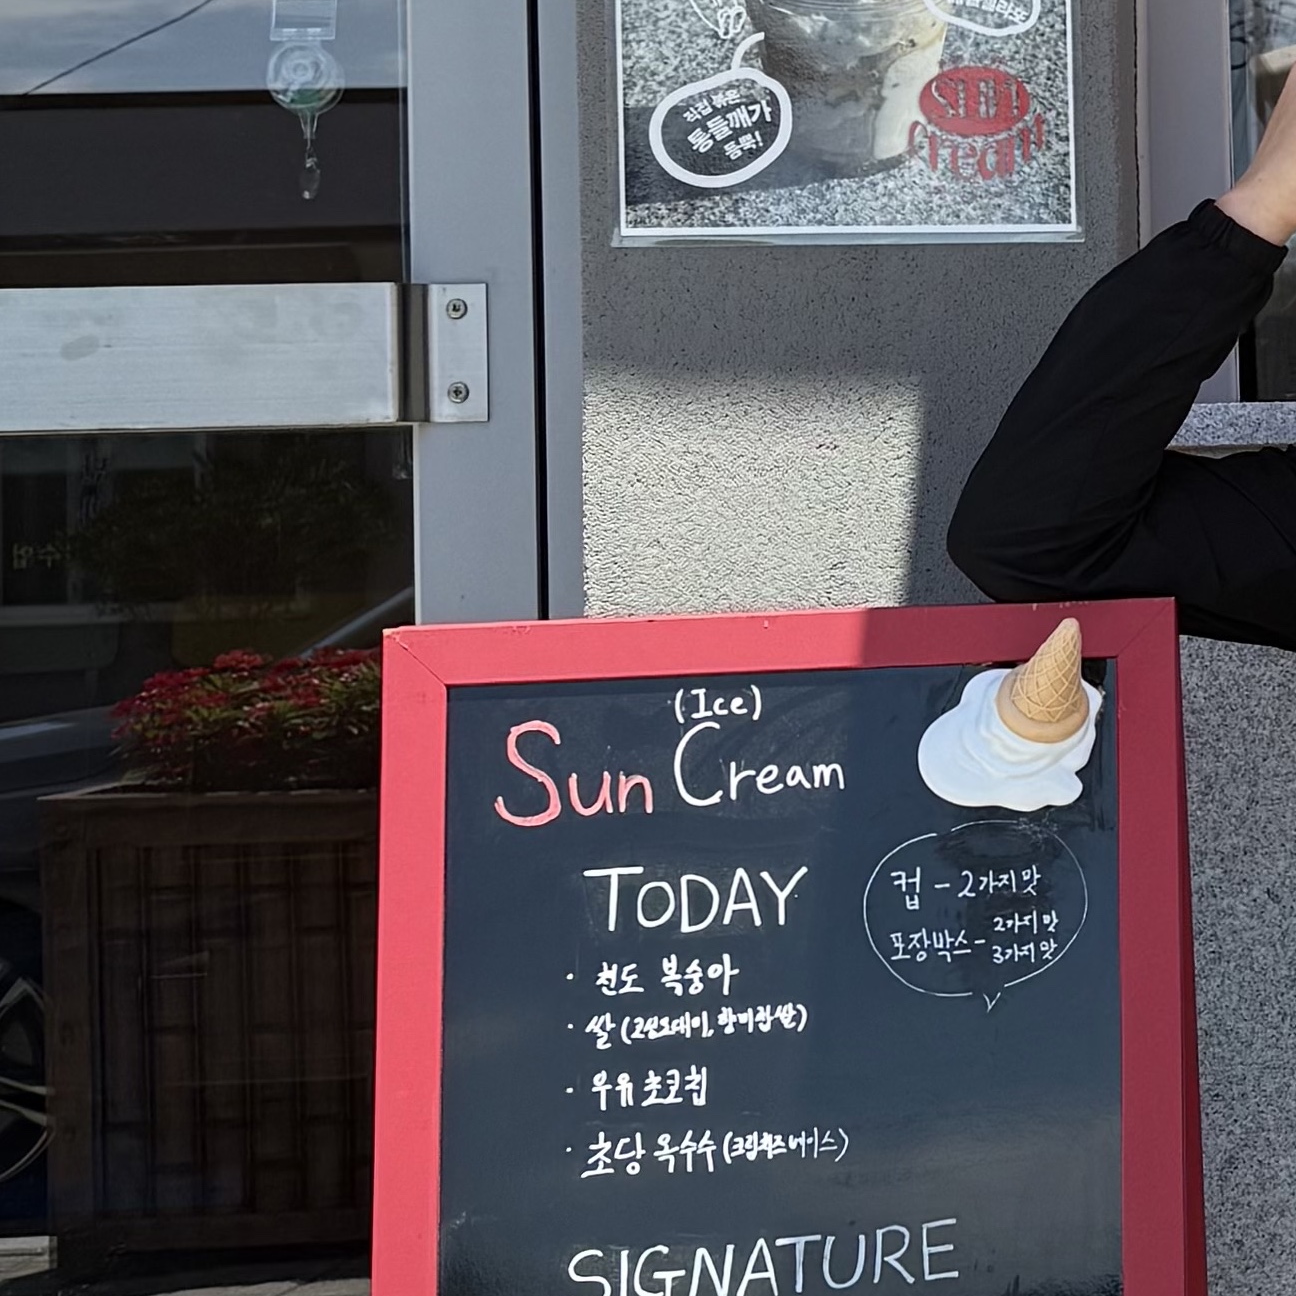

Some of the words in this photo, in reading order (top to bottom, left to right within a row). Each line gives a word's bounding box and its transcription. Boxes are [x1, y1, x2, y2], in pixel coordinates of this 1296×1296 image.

[673, 685, 762, 721] (Ice)
[494, 719, 654, 826] Sun
[673, 721, 846, 806] Cream
[583, 865, 808, 934] TODAY
[890, 866, 922, 910] 컵
[1021, 864, 1042, 896] 맛
[889, 927, 973, 964] 포장박스
[594, 960, 645, 996] 천도
[660, 952, 741, 997] 복숭아
[584, 1011, 617, 1050] 쌀
[591, 1068, 635, 1112] 우유
[641, 1064, 708, 1109] 초코칩
[580, 1130, 646, 1179] 초당
